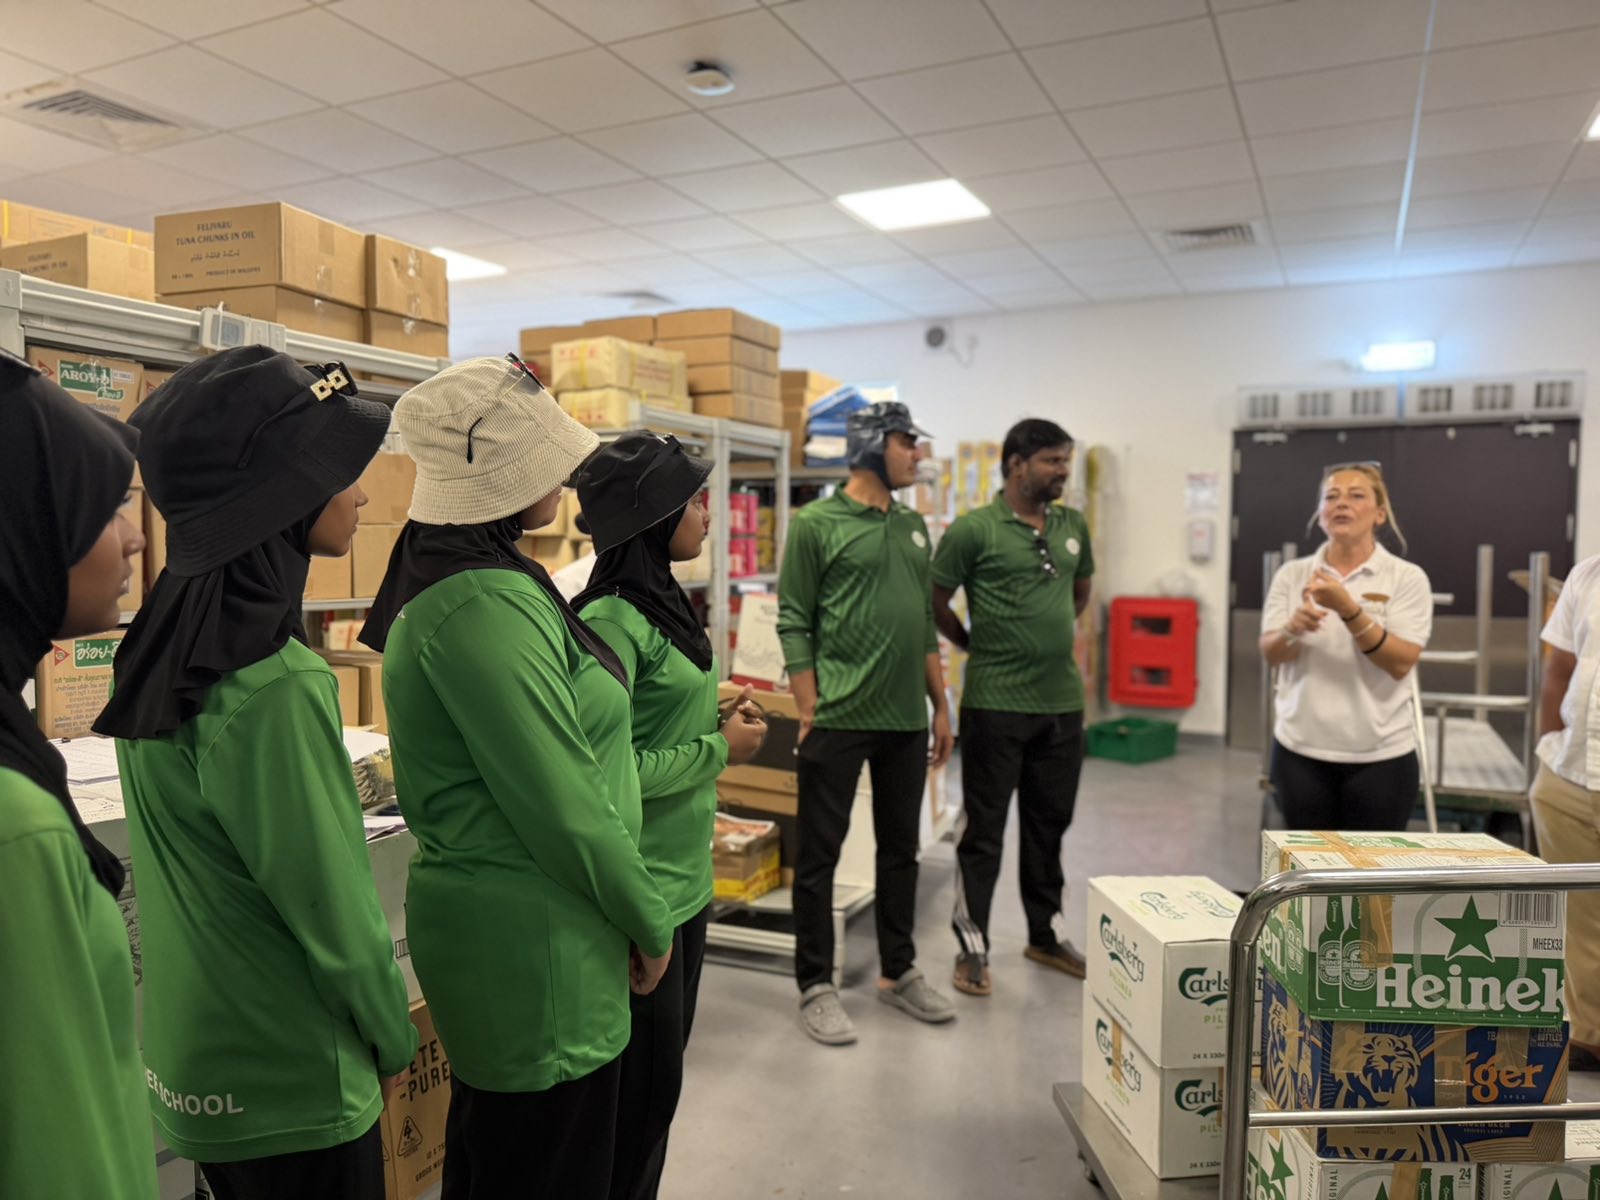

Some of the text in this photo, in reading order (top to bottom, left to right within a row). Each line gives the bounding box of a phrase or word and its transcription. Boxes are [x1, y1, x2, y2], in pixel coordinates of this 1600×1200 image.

[176, 231, 256, 246] TUNA CHUNKS IN OIL
[1100, 913, 1145, 983] Carlsberg
[1178, 967, 1230, 1001] Carls
[1204, 1014, 1224, 1025] PIL
[1438, 1052, 1543, 1103] Tiger
[1174, 1079, 1224, 1111] Carls
[1459, 1168, 1471, 1180] 24
